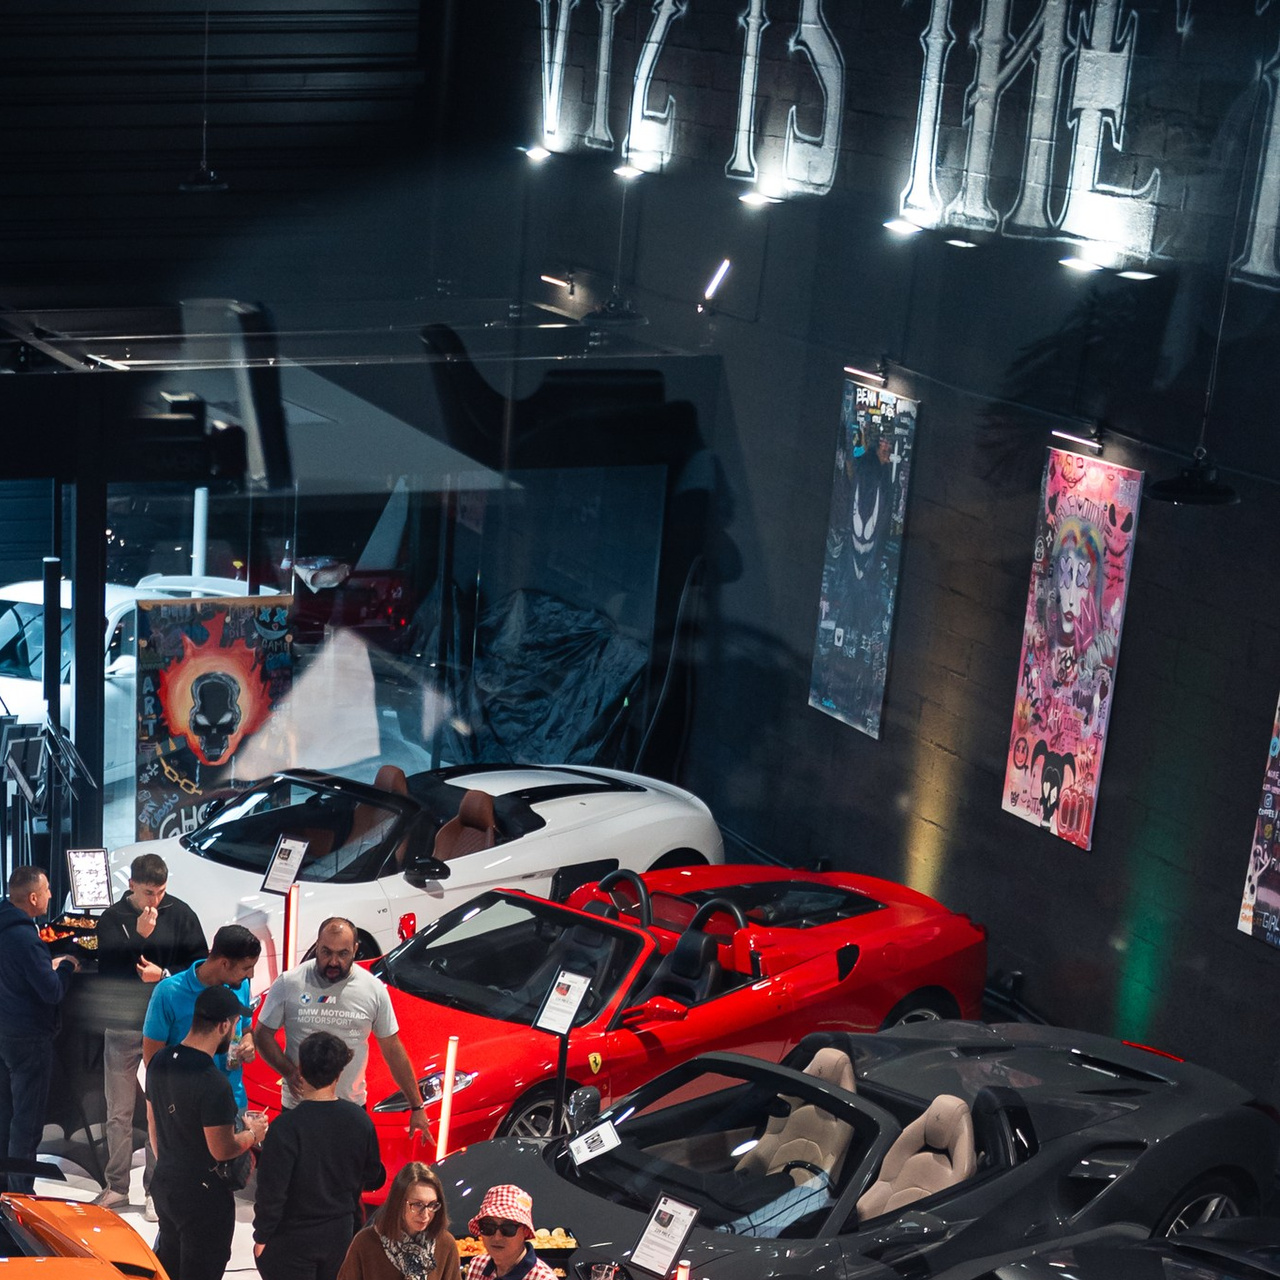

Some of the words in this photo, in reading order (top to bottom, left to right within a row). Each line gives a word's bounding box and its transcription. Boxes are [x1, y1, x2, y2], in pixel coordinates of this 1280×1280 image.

[297, 1008, 319, 1016] BMW
[320, 1009, 367, 1020] MOTORRAD
[297, 1016, 353, 1026] MOTORSPORT
